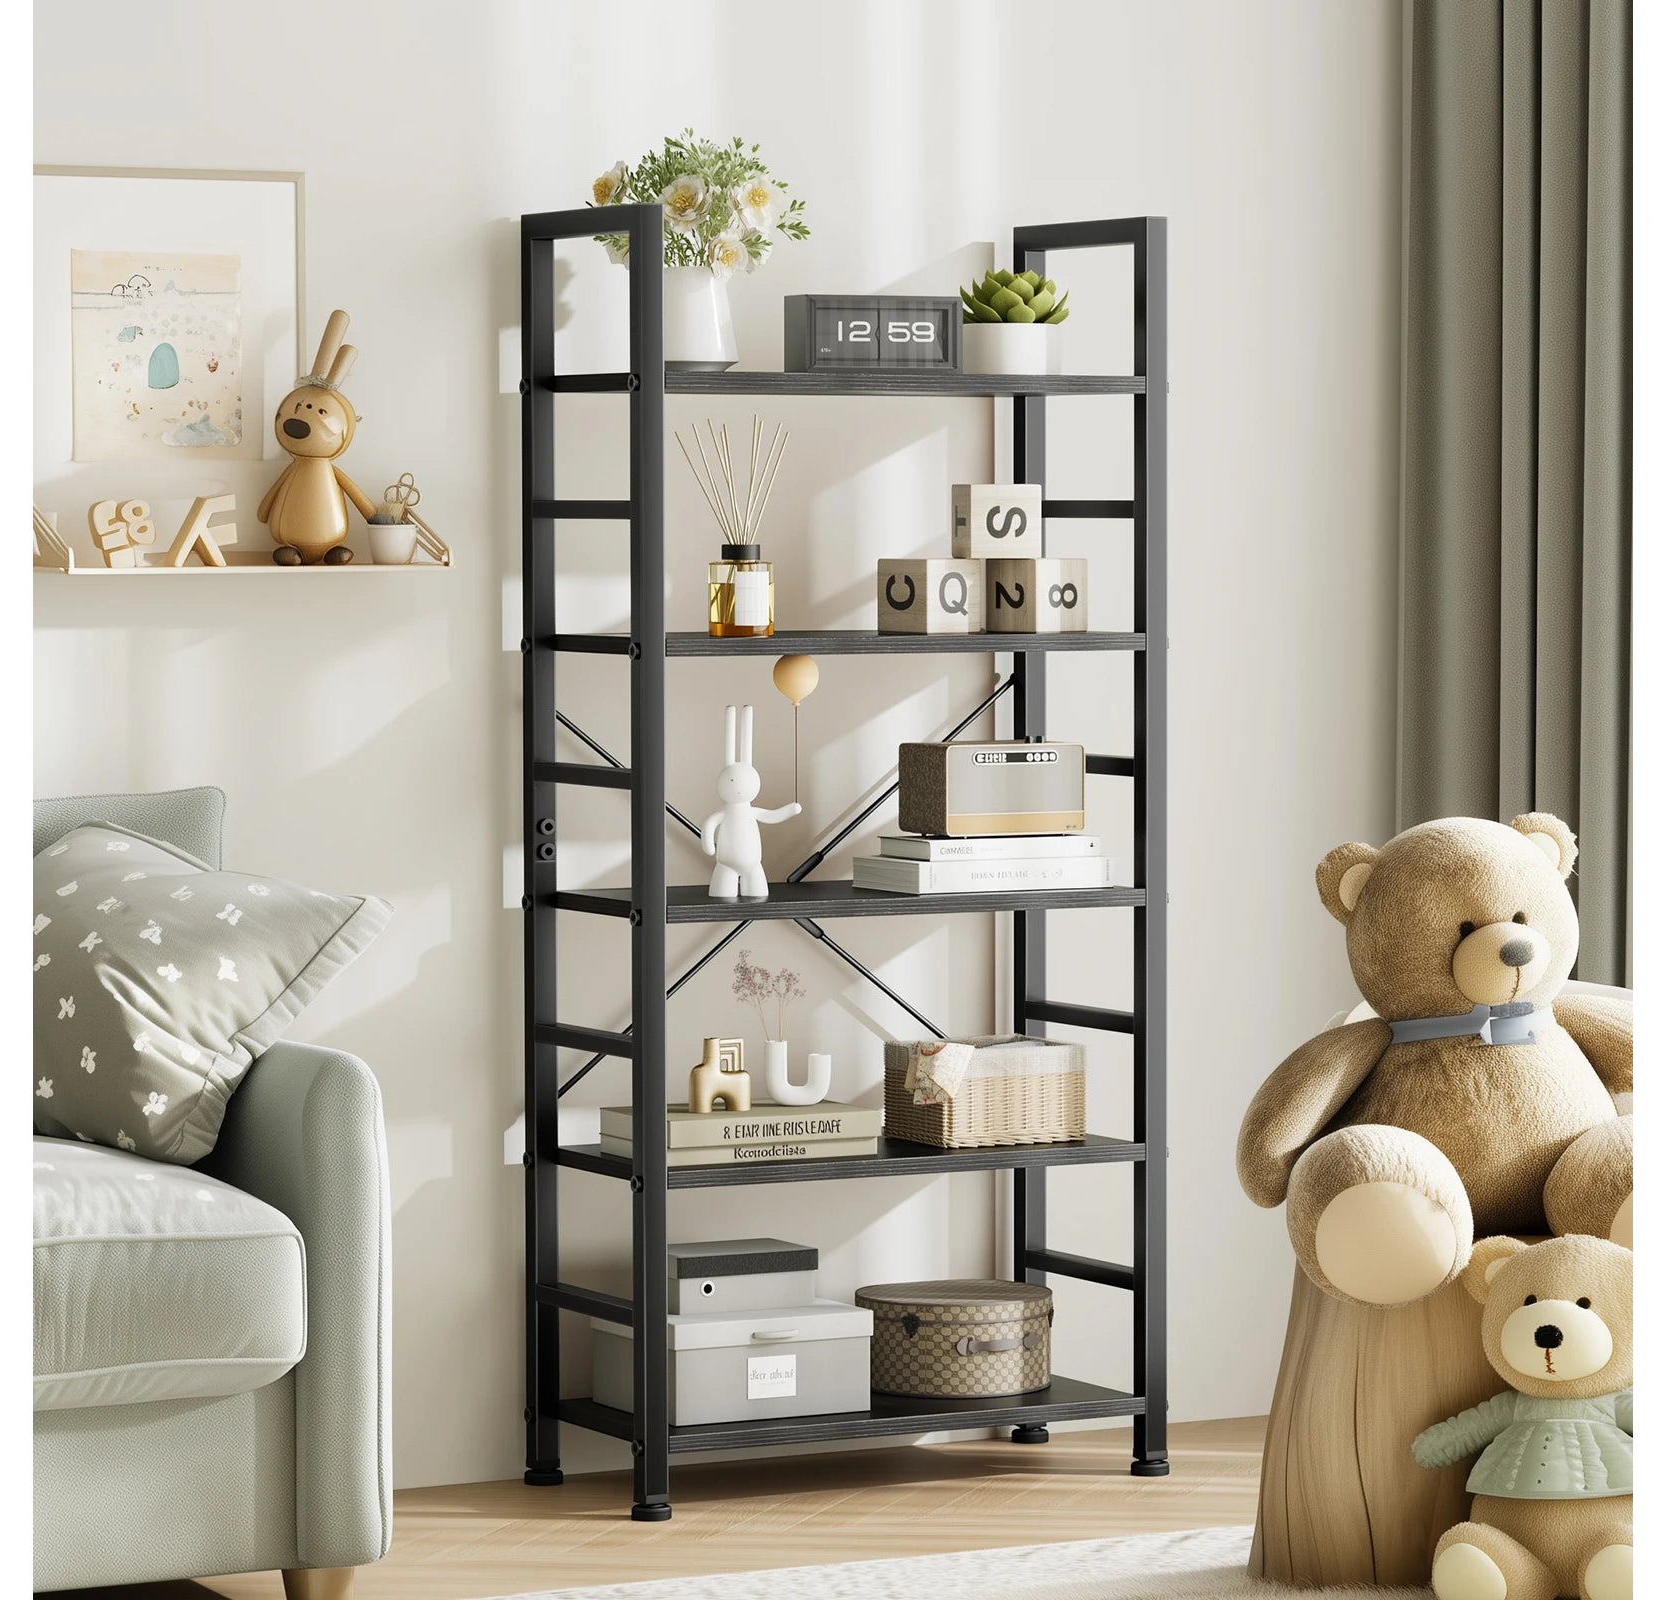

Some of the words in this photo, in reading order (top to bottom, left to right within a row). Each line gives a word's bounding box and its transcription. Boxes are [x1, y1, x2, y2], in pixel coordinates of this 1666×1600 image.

[837, 320, 871, 342] 12
[887, 321, 935, 343] 59
[986, 505, 1027, 539] S
[885, 574, 915, 610] C
[939, 571, 968, 616] Q
[995, 581, 1025, 609] 2
[1048, 582, 1078, 609] 8
